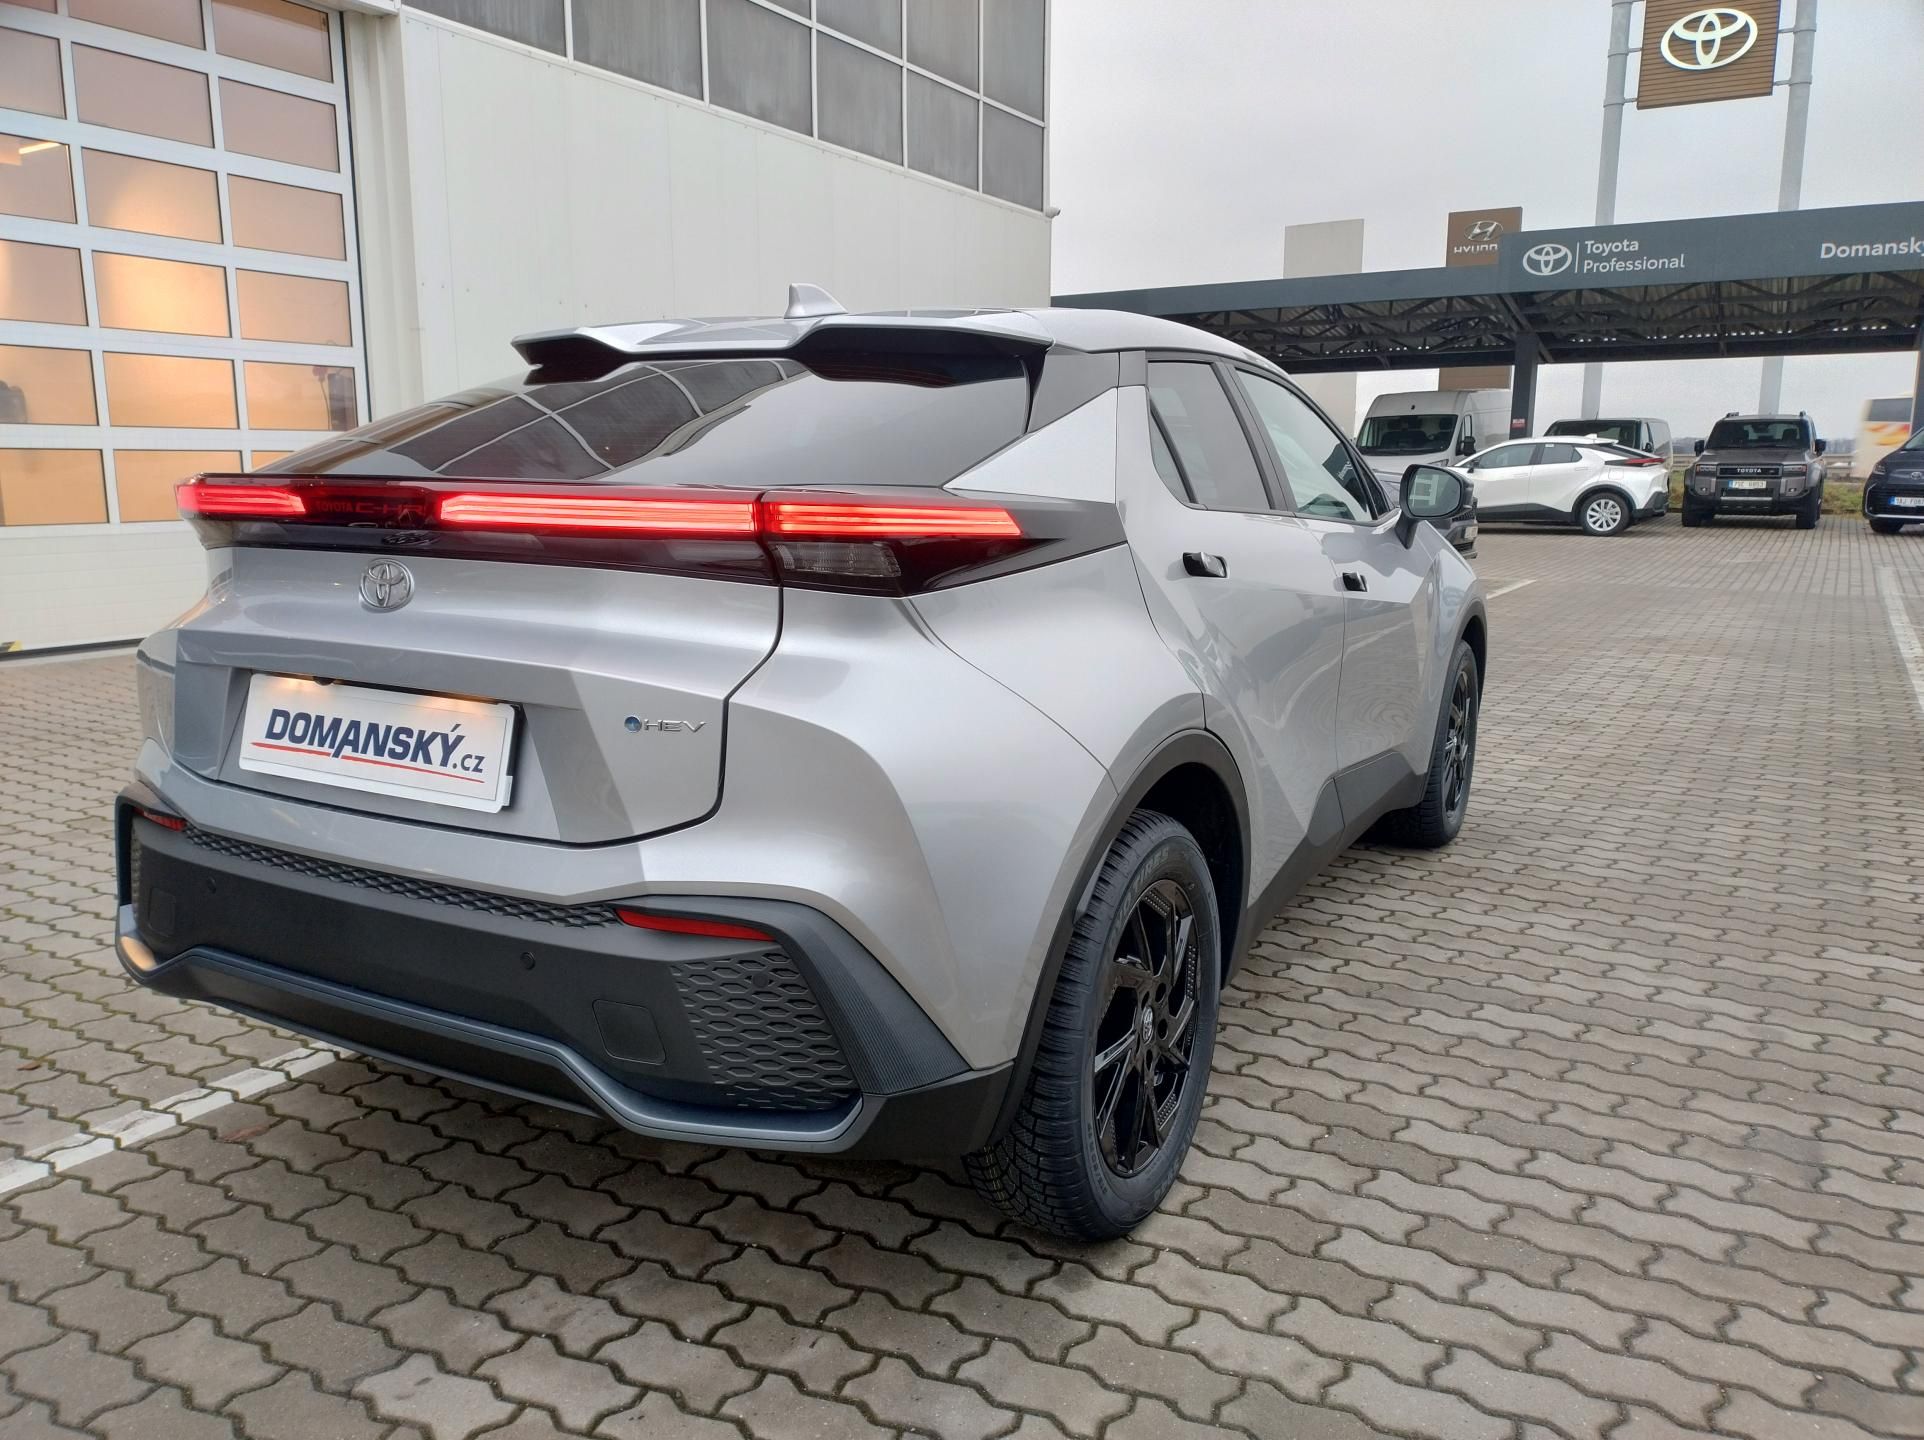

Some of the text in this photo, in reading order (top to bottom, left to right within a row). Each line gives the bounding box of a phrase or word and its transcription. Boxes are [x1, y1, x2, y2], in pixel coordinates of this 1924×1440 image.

[1584, 239, 1640, 256] Toyota
[1583, 253, 1685, 274] Professional
[315, 501, 352, 512] TOYOTA
[643, 718, 706, 733] HEV
